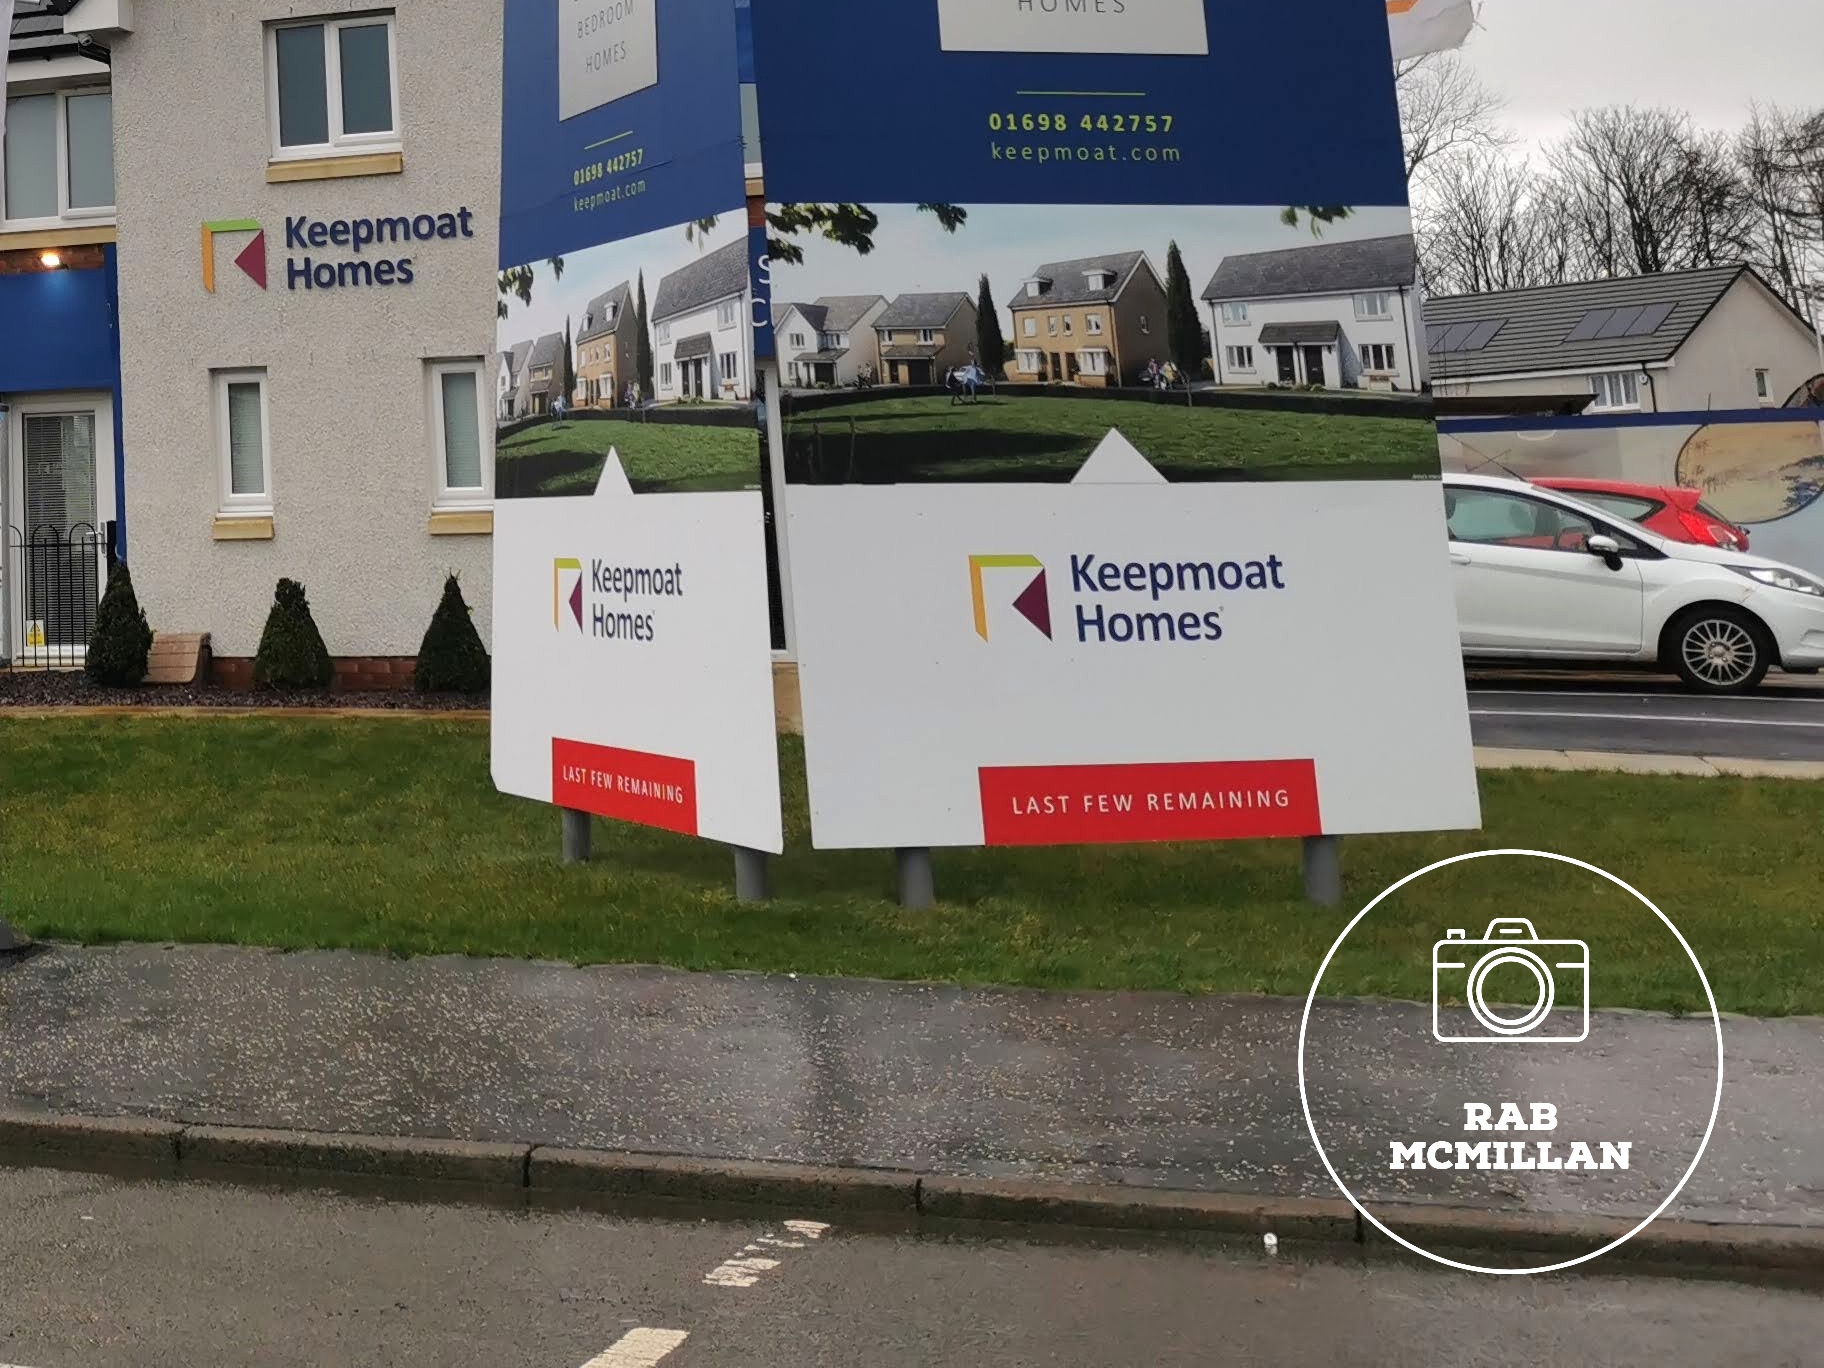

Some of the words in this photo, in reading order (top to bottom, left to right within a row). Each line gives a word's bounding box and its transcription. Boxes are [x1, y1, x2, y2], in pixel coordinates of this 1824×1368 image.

[586, 41, 626, 72] HOMES
[989, 112, 1067, 131] 01698
[1080, 113, 1174, 132] 442757
[574, 163, 603, 185] 01698
[607, 149, 643, 174] 442757
[992, 144, 1179, 161] keepmoat.com
[574, 180, 645, 211] keepmoat.com
[285, 206, 474, 252] Keepmoat
[287, 257, 414, 290] Homes
[592, 558, 683, 602] Keepmoat
[1070, 554, 1285, 600] Keepmoat
[592, 603, 655, 642] Homes
[1075, 604, 1223, 642] Homes
[563, 765, 586, 783] LAST
[591, 770, 612, 789] FEW
[617, 775, 684, 804] REMAINING
[1012, 795, 1070, 815] LAST
[1083, 794, 1133, 812] FEW
[1147, 790, 1289, 810] REMAINING
